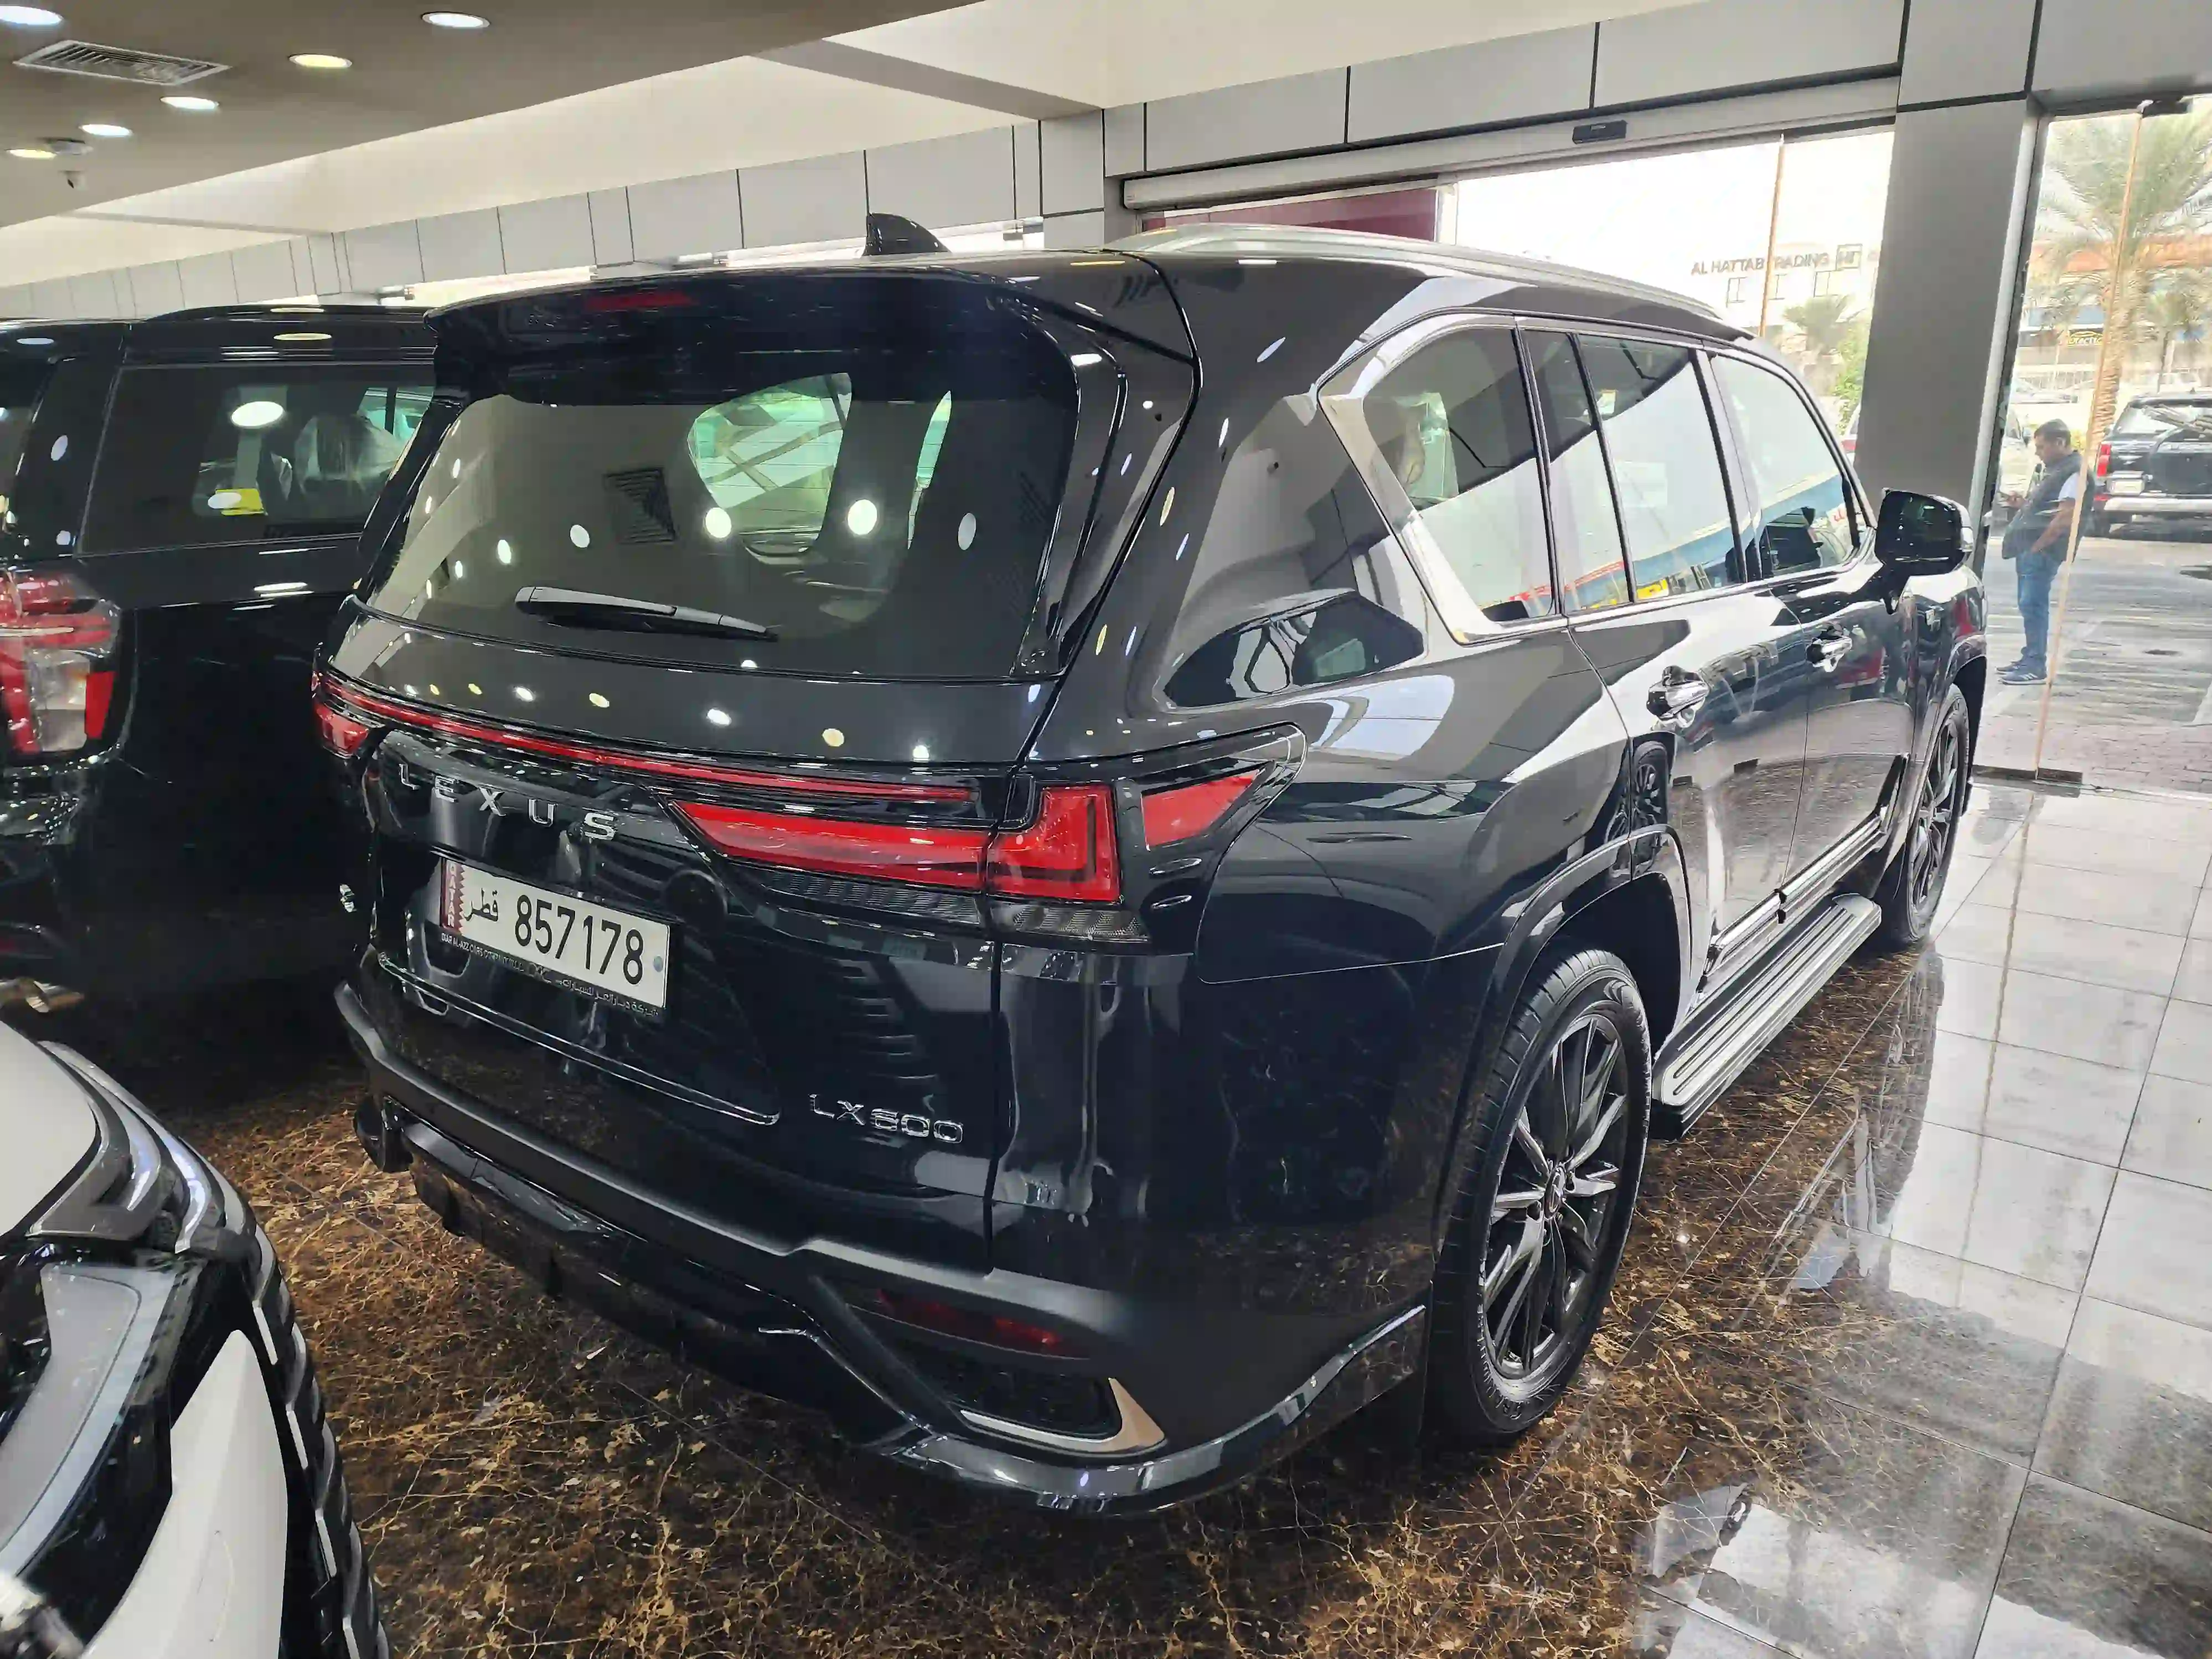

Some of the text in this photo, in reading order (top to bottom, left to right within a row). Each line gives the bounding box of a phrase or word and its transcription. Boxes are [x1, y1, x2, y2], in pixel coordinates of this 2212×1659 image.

[1774, 252, 1829, 270] RADING
[399, 763, 617, 840] LEXUS
[447, 862, 457, 928] QATAR
[464, 887, 498, 922] قطر
[515, 895, 643, 985] 857178
